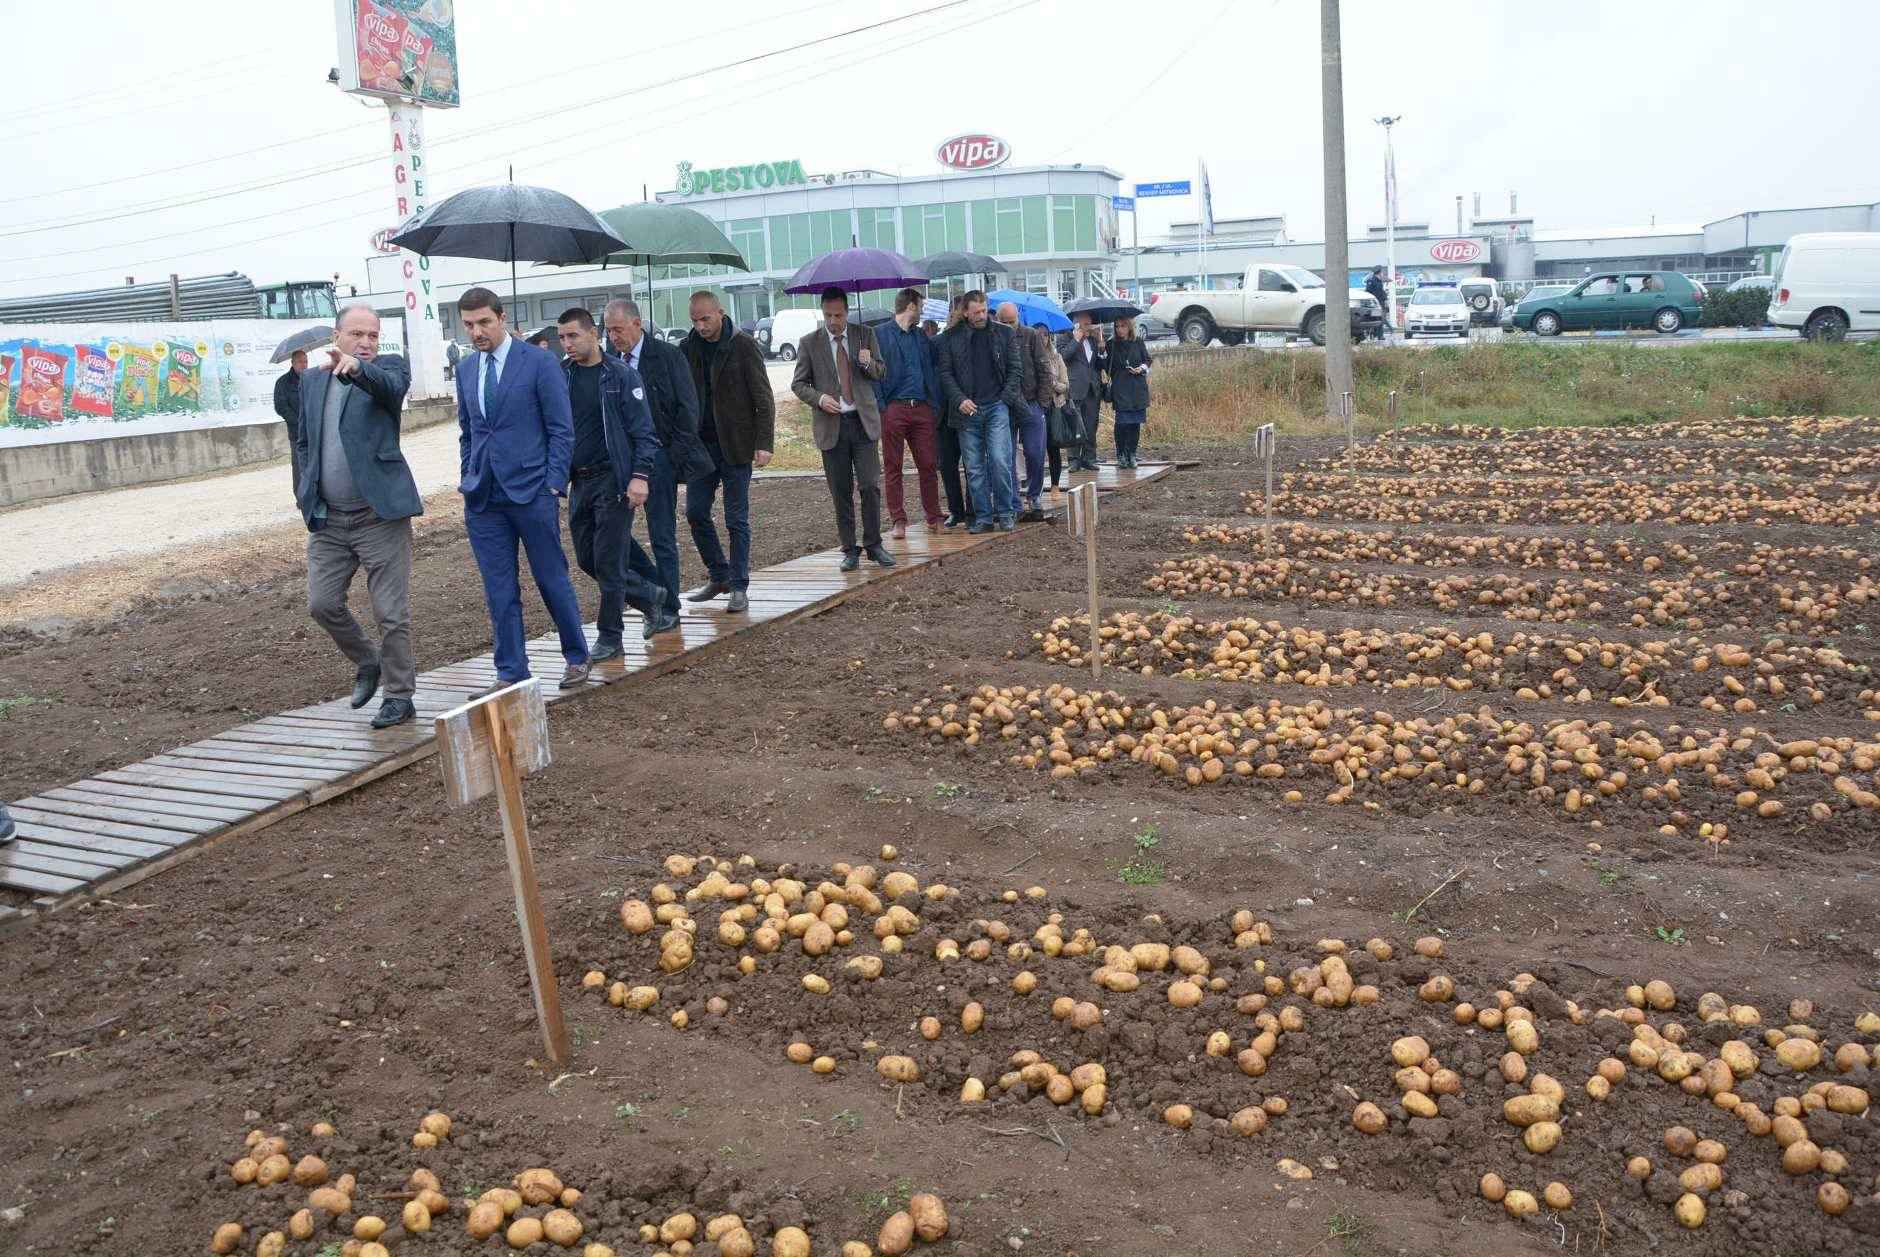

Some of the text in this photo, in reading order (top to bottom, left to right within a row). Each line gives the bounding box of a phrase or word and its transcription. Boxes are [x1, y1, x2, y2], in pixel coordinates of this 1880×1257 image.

[368, 17, 395, 39] vipa
[943, 137, 1000, 167] vipa
[693, 158, 806, 194] PESTOVA
[393, 132, 417, 310] AGRCO
[410, 154, 434, 321] PESOVA
[1437, 240, 1475, 260] vipa
[375, 342, 401, 352] STOVA
[31, 358, 56, 373] vipa
